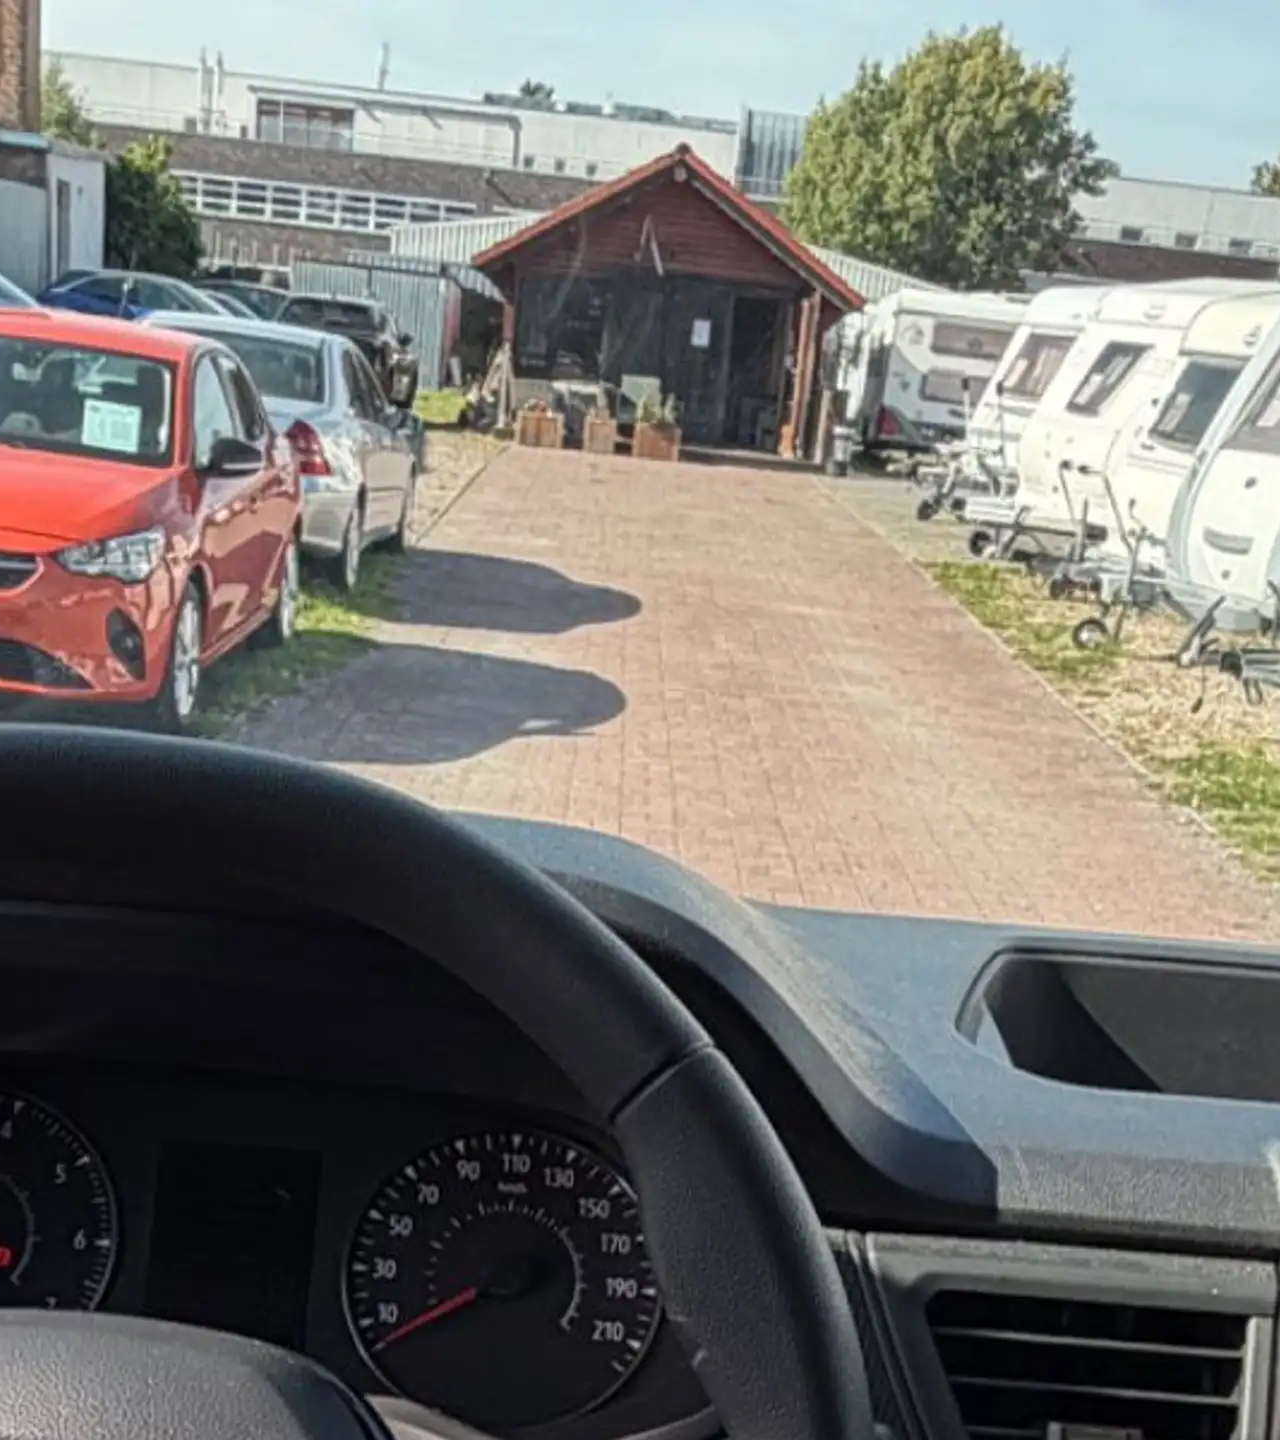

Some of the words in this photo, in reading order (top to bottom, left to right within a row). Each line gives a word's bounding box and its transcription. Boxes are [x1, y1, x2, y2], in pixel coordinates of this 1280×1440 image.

[55, 1161, 68, 1184] 5
[457, 1160, 481, 1181] 90
[501, 1153, 531, 1174] 110
[544, 1167, 574, 1189] 130
[417, 1182, 440, 1205] 70
[577, 1198, 611, 1219] 150
[389, 1214, 413, 1237] 50
[73, 1229, 88, 1250] 6
[600, 1233, 631, 1255] 170
[374, 1258, 397, 1279] 30
[605, 1277, 638, 1300] 190
[378, 1302, 399, 1324] 10
[592, 1320, 624, 1342] 210
